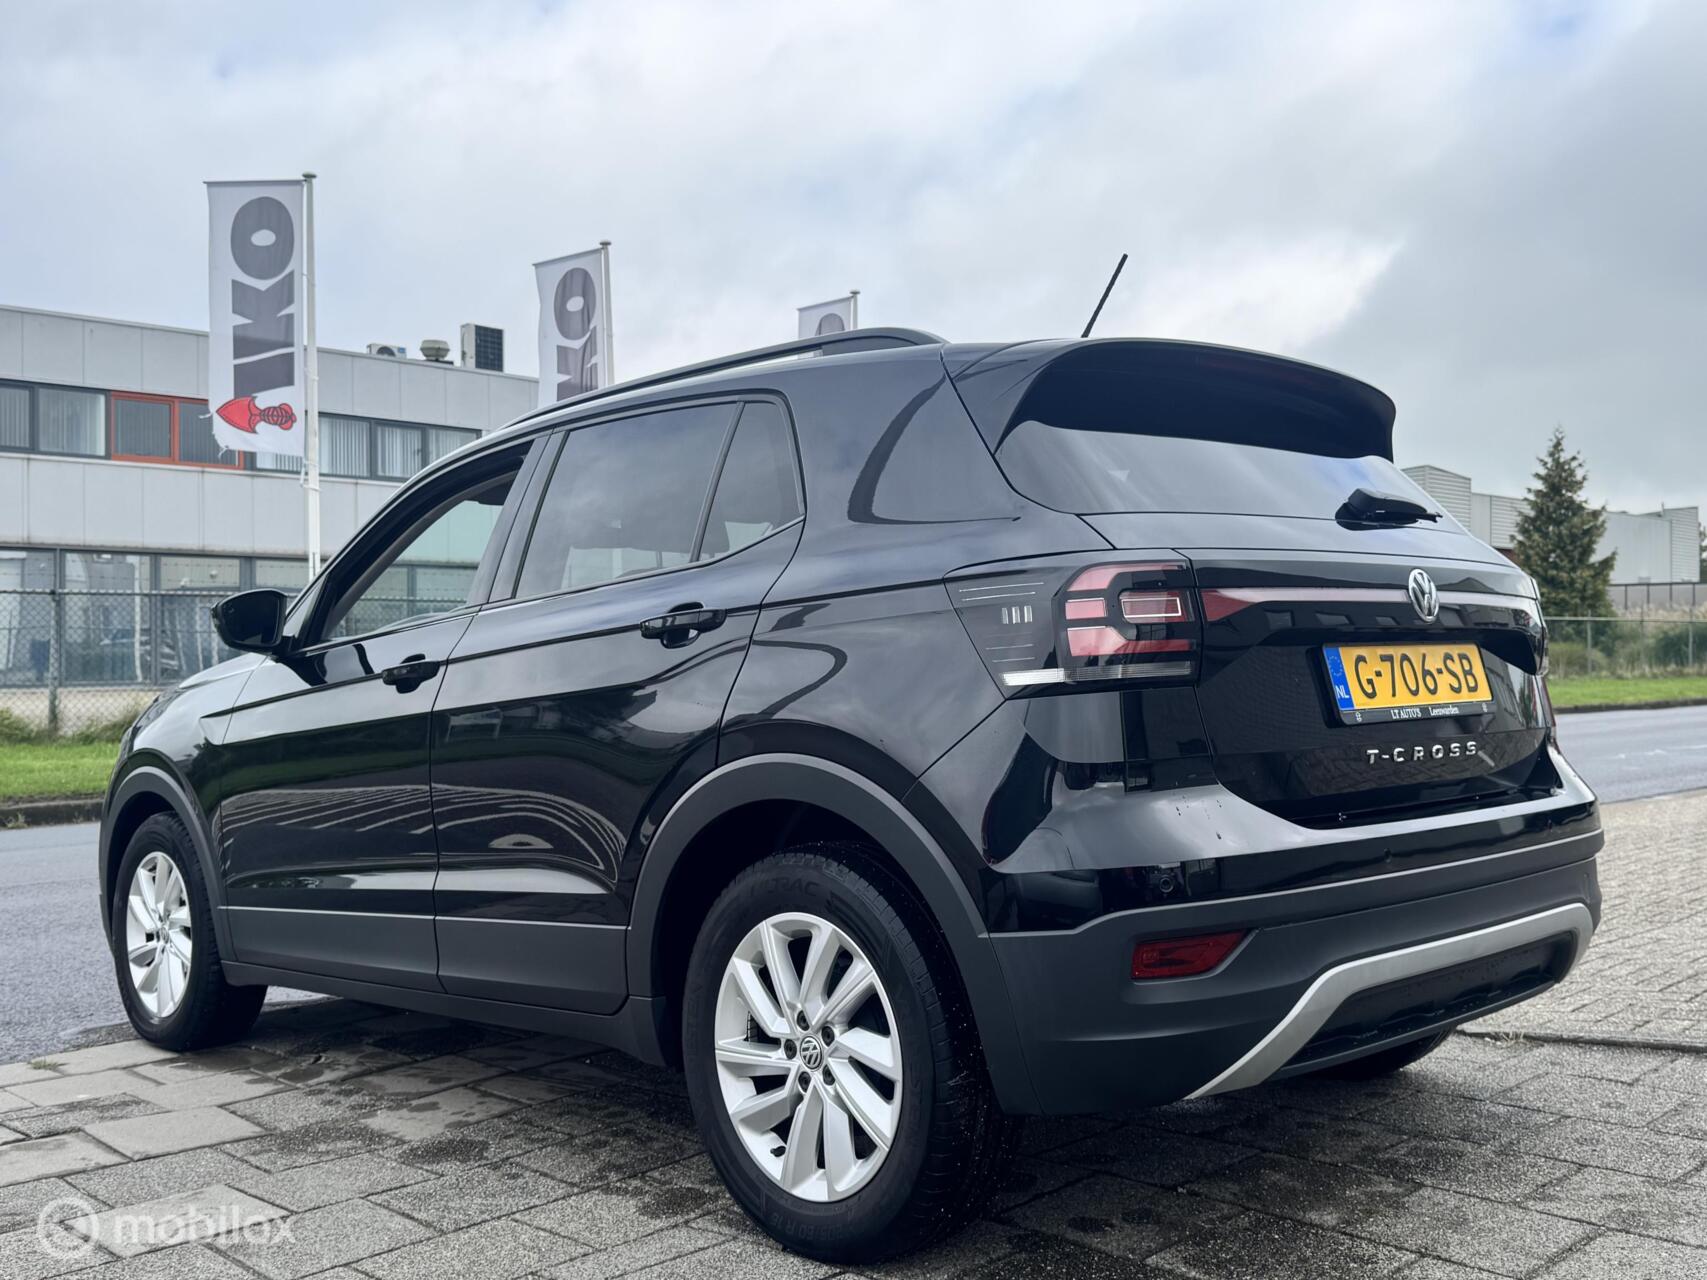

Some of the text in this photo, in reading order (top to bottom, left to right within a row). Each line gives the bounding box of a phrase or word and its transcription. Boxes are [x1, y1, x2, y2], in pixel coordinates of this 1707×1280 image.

[230, 196, 295, 399] IKO
[553, 267, 598, 401] KO
[1335, 685, 1350, 699] NL
[1354, 652, 1479, 699] G-706-SB
[1366, 741, 1477, 764] T-CROSS
